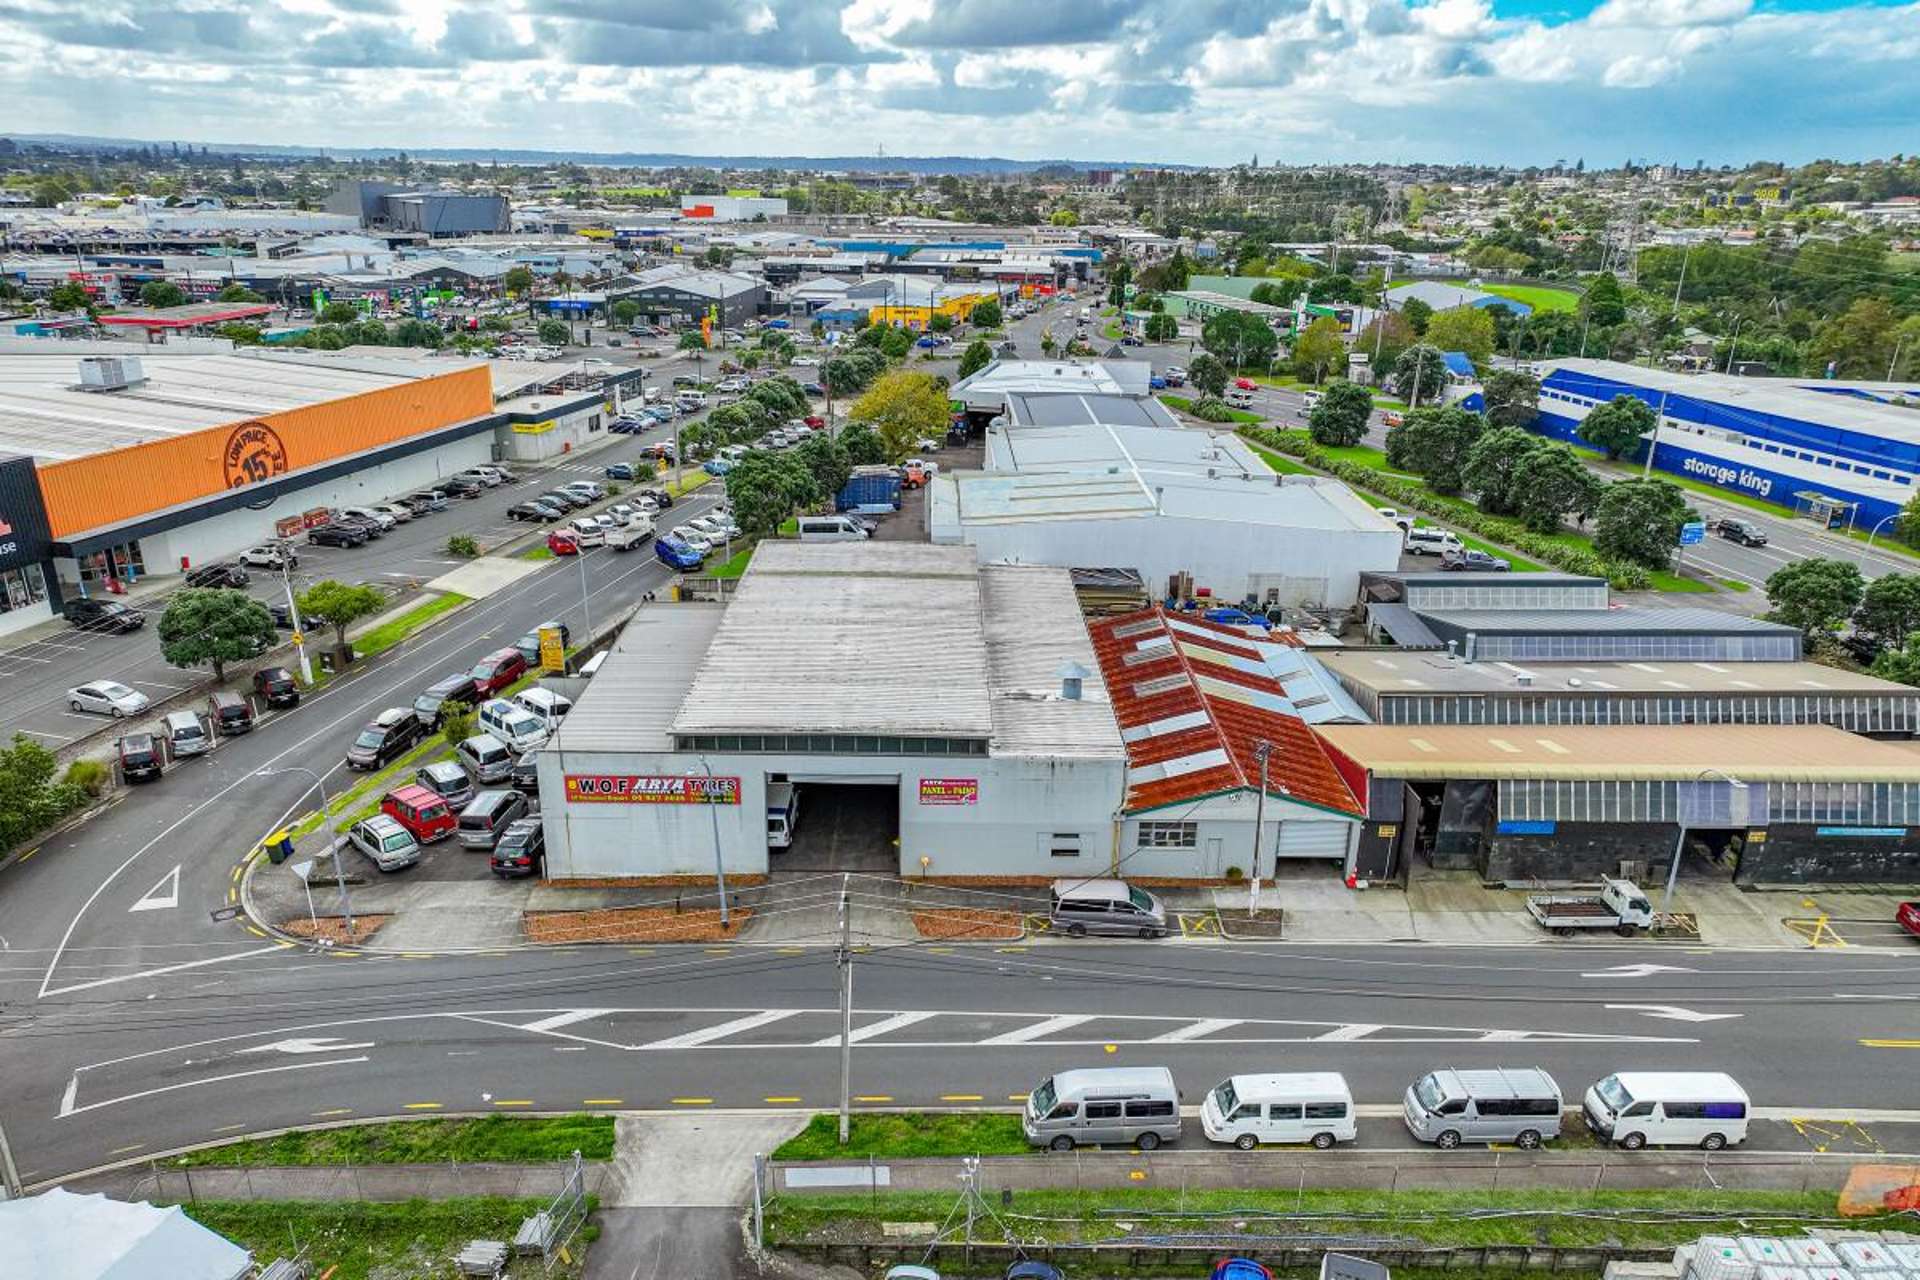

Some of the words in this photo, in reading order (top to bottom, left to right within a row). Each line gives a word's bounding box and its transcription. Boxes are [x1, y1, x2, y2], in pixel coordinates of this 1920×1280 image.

[229, 439, 244, 468] LOW
[241, 430, 267, 446] PRICE
[1684, 458, 1737, 484] storage
[1739, 469, 1772, 496] king
[579, 779, 628, 794] W.O.F
[633, 778, 685, 791] ARYA
[688, 779, 737, 792] TYRES
